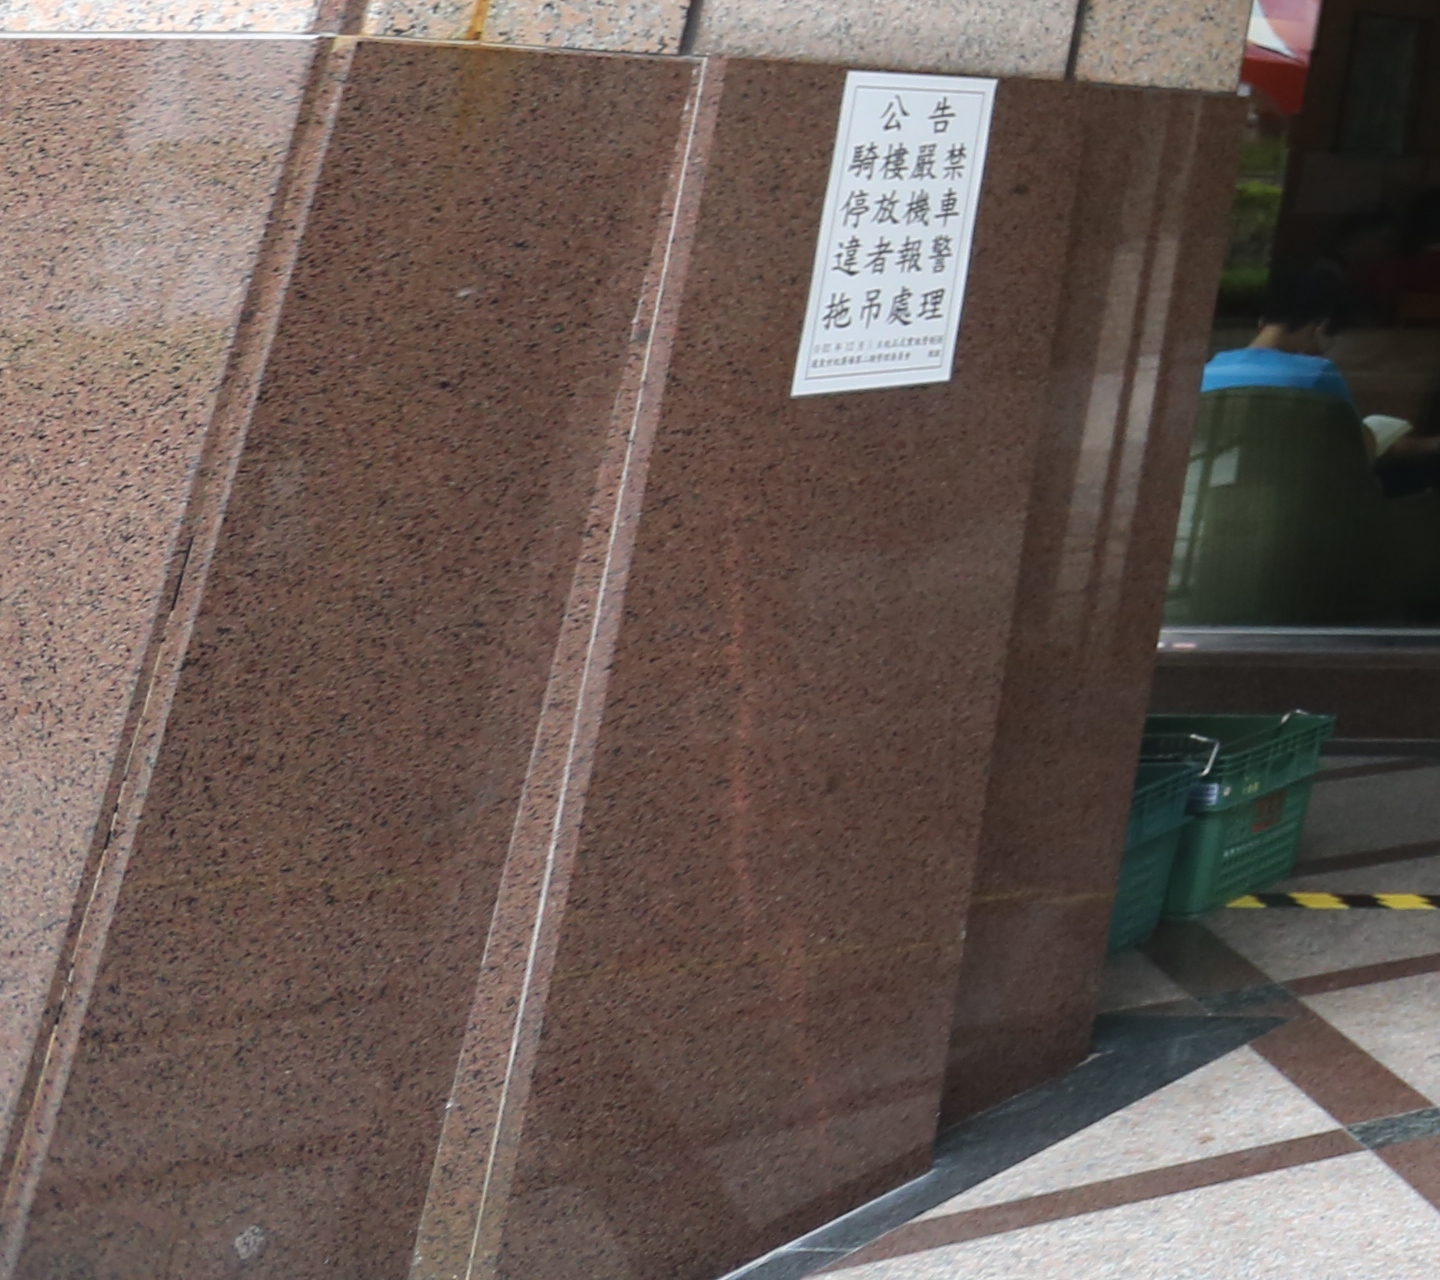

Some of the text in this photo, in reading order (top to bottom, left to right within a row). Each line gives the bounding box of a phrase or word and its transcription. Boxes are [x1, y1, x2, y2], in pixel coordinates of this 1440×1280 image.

[880, 94, 956, 134] 公告
[848, 143, 967, 181] 騎樓嚴禁
[841, 187, 960, 228] 停放機車
[831, 235, 953, 277] 違者報警
[822, 287, 945, 329] 拖吊處理
